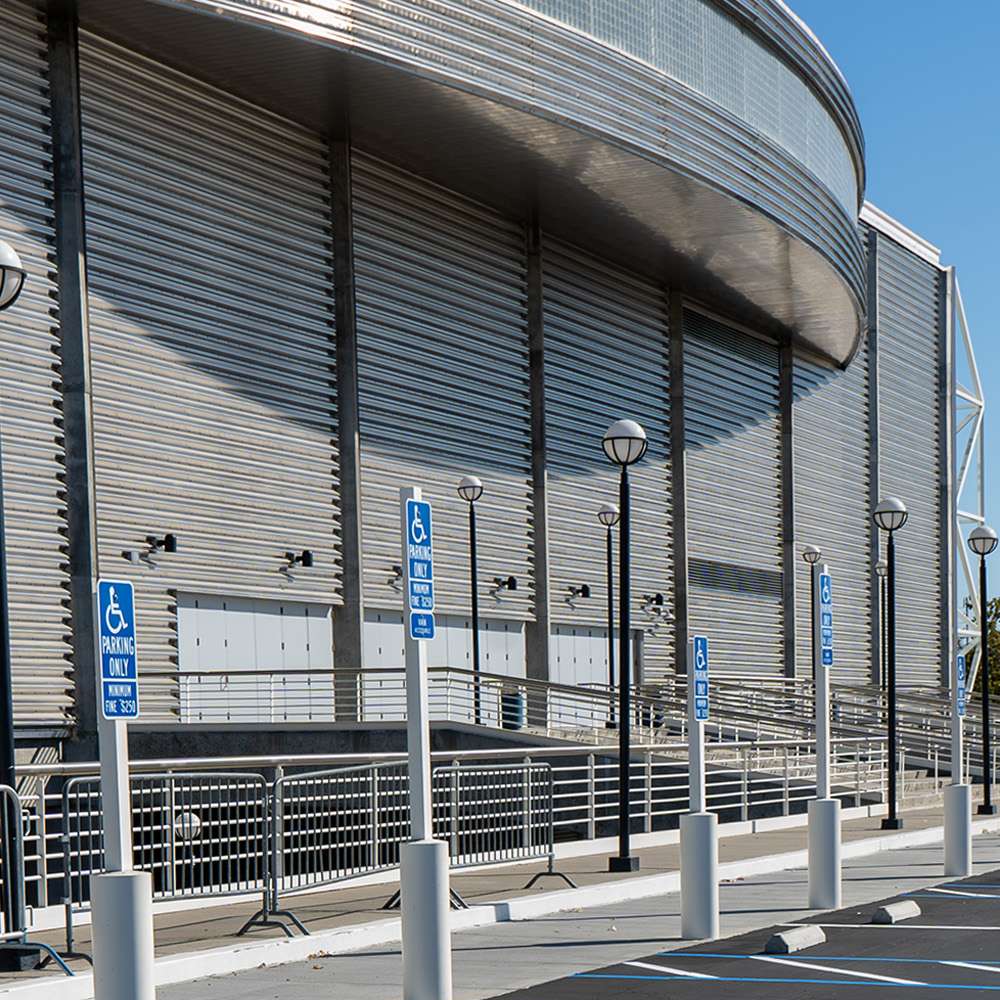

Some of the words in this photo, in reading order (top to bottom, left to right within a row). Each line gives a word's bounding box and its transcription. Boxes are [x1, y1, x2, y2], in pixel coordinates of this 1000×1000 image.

[409, 544, 431, 560] PARKING
[102, 636, 134, 655] PARKING
[109, 657, 129, 677] ONLY
[108, 684, 132, 697] MINIMUM
[105, 700, 118, 713] FINE
[119, 699, 136, 714] $250
